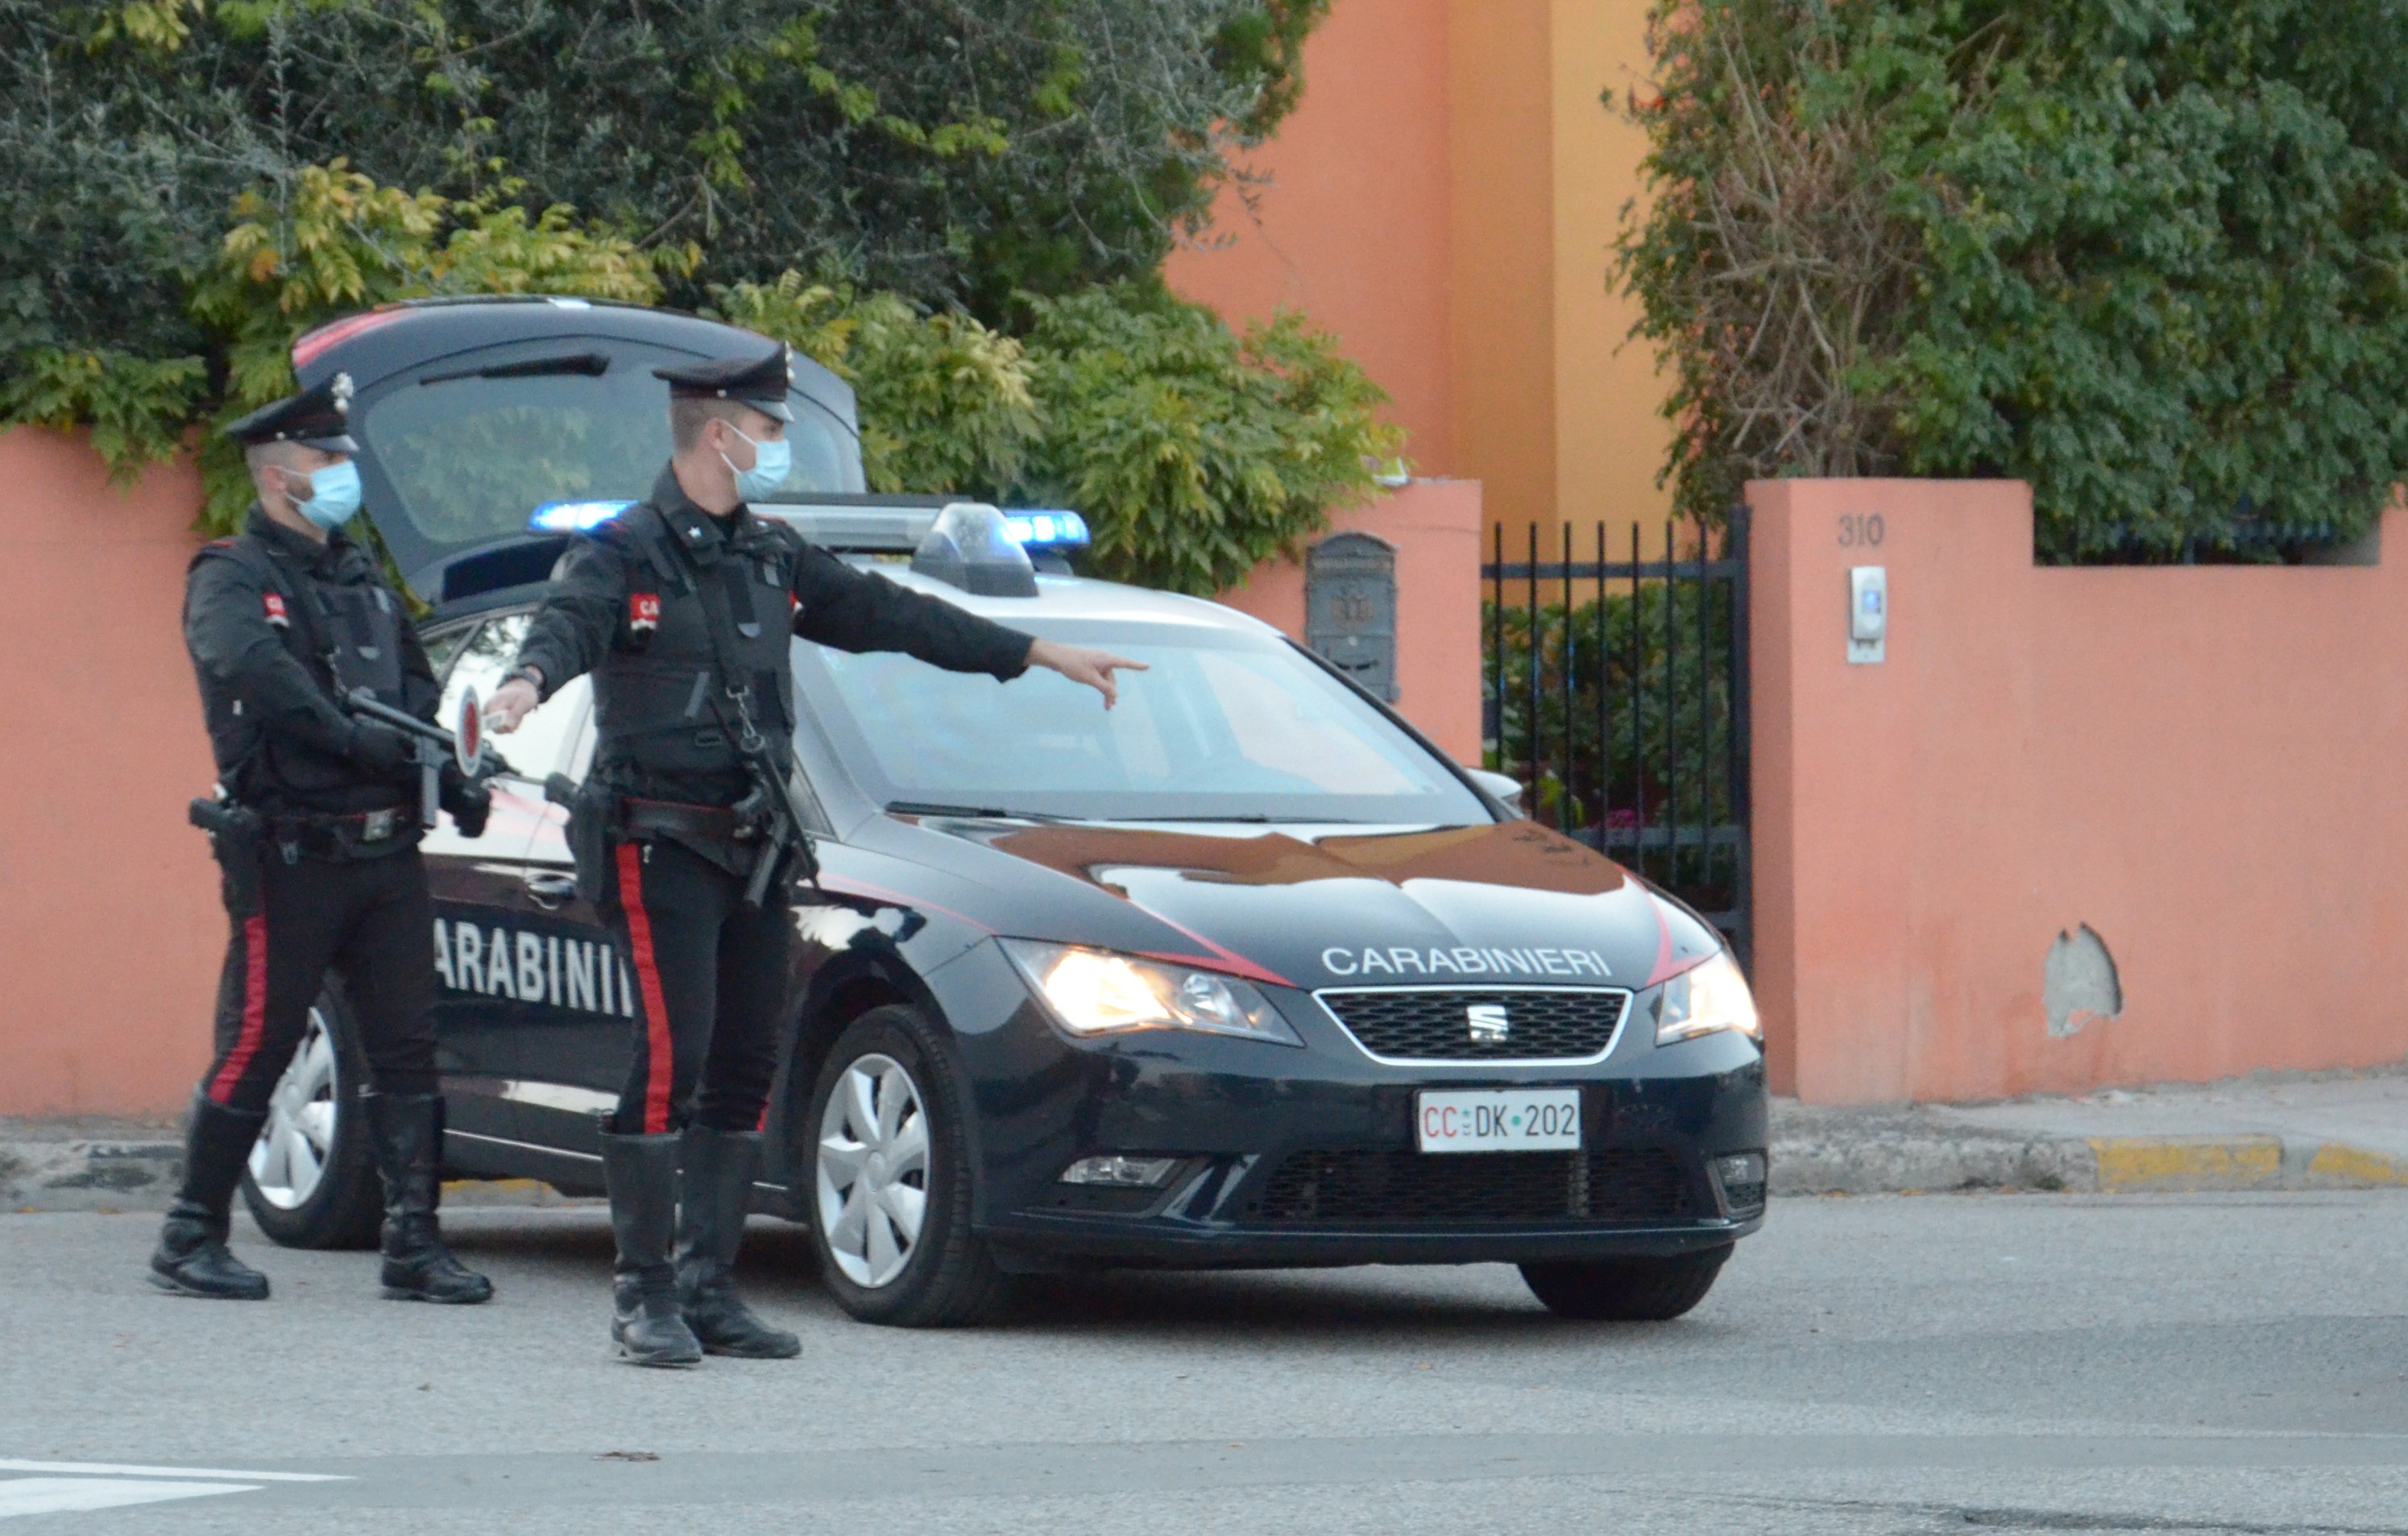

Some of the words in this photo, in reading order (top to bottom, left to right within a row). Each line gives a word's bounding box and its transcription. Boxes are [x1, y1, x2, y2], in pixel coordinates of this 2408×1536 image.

[1838, 513, 1884, 546] 310
[1321, 947, 1612, 976] CARABINIERI
[1424, 1106, 1457, 1137] CC
[1476, 1105, 1507, 1136] DK
[1525, 1104, 1575, 1136] 202
